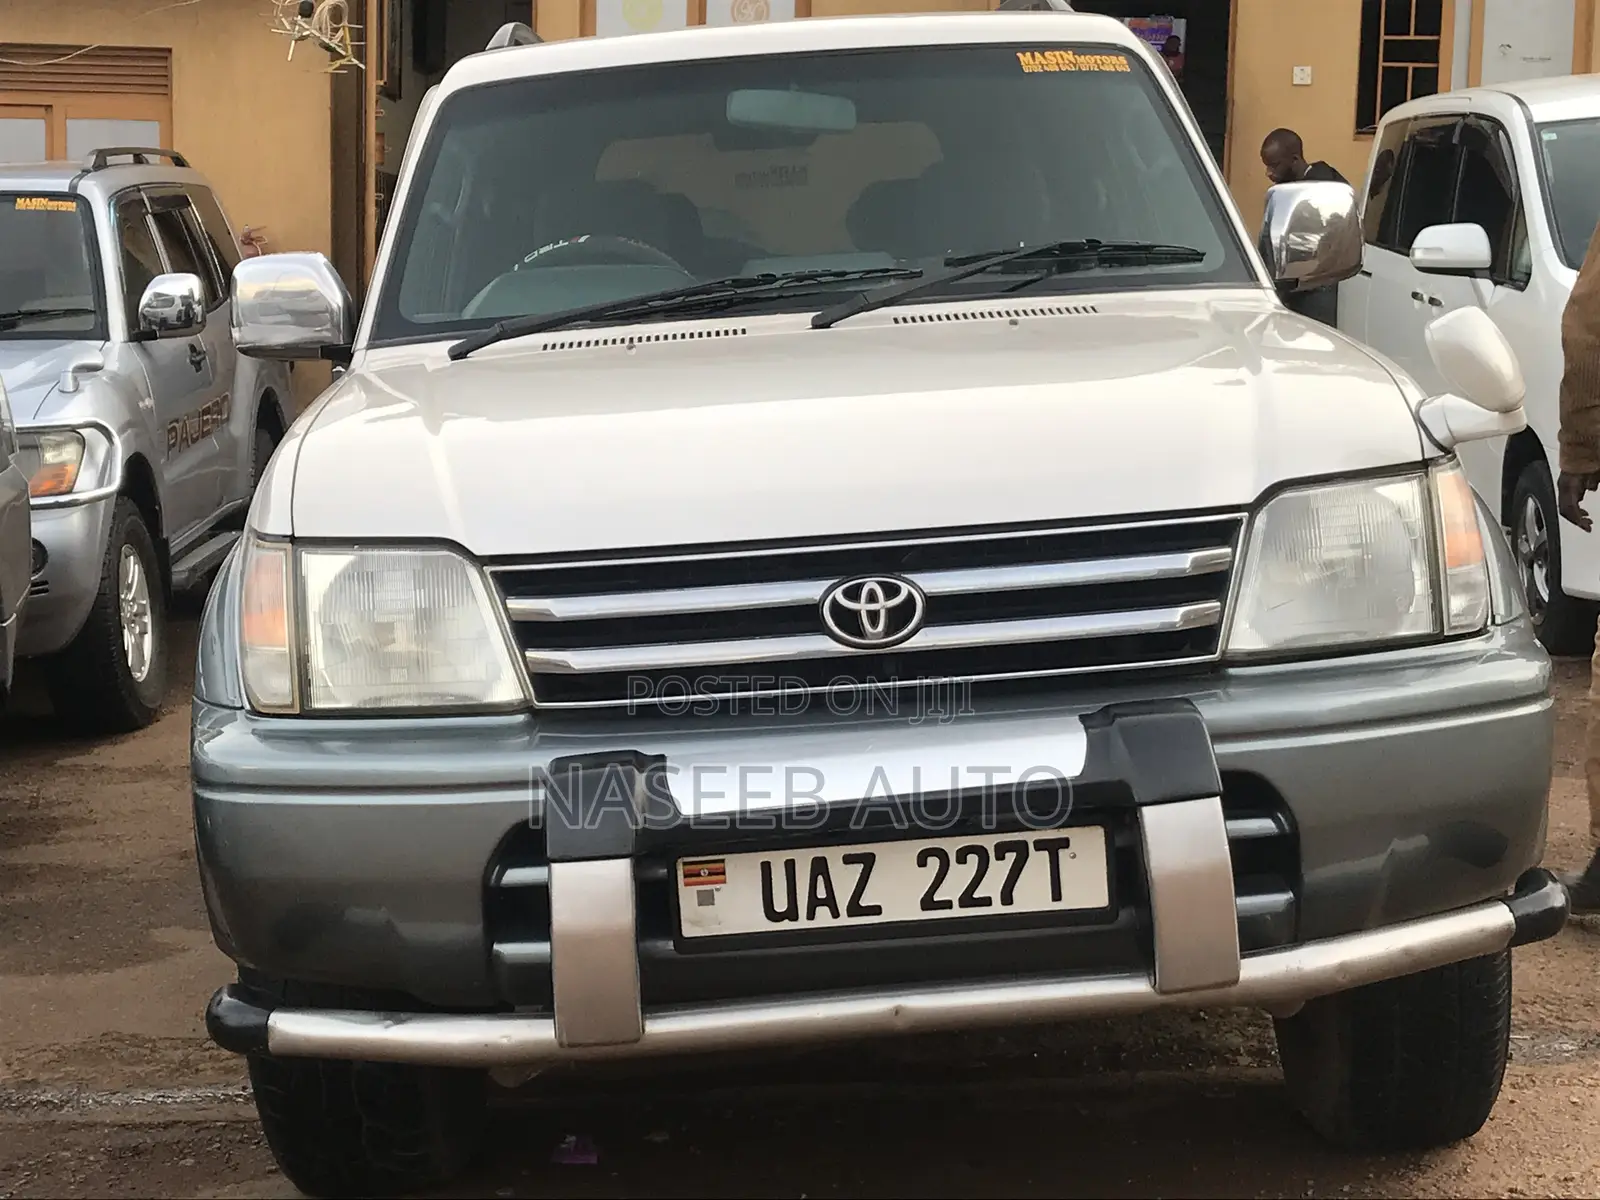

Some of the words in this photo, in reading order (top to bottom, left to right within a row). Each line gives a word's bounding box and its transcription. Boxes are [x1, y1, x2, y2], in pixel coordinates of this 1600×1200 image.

[1016, 50, 1076, 65] MASIN
[1075, 54, 1128, 65] MOTORS
[166, 391, 232, 461] PAJERO
[760, 852, 883, 923] UAZ
[916, 837, 1071, 912] 227T
